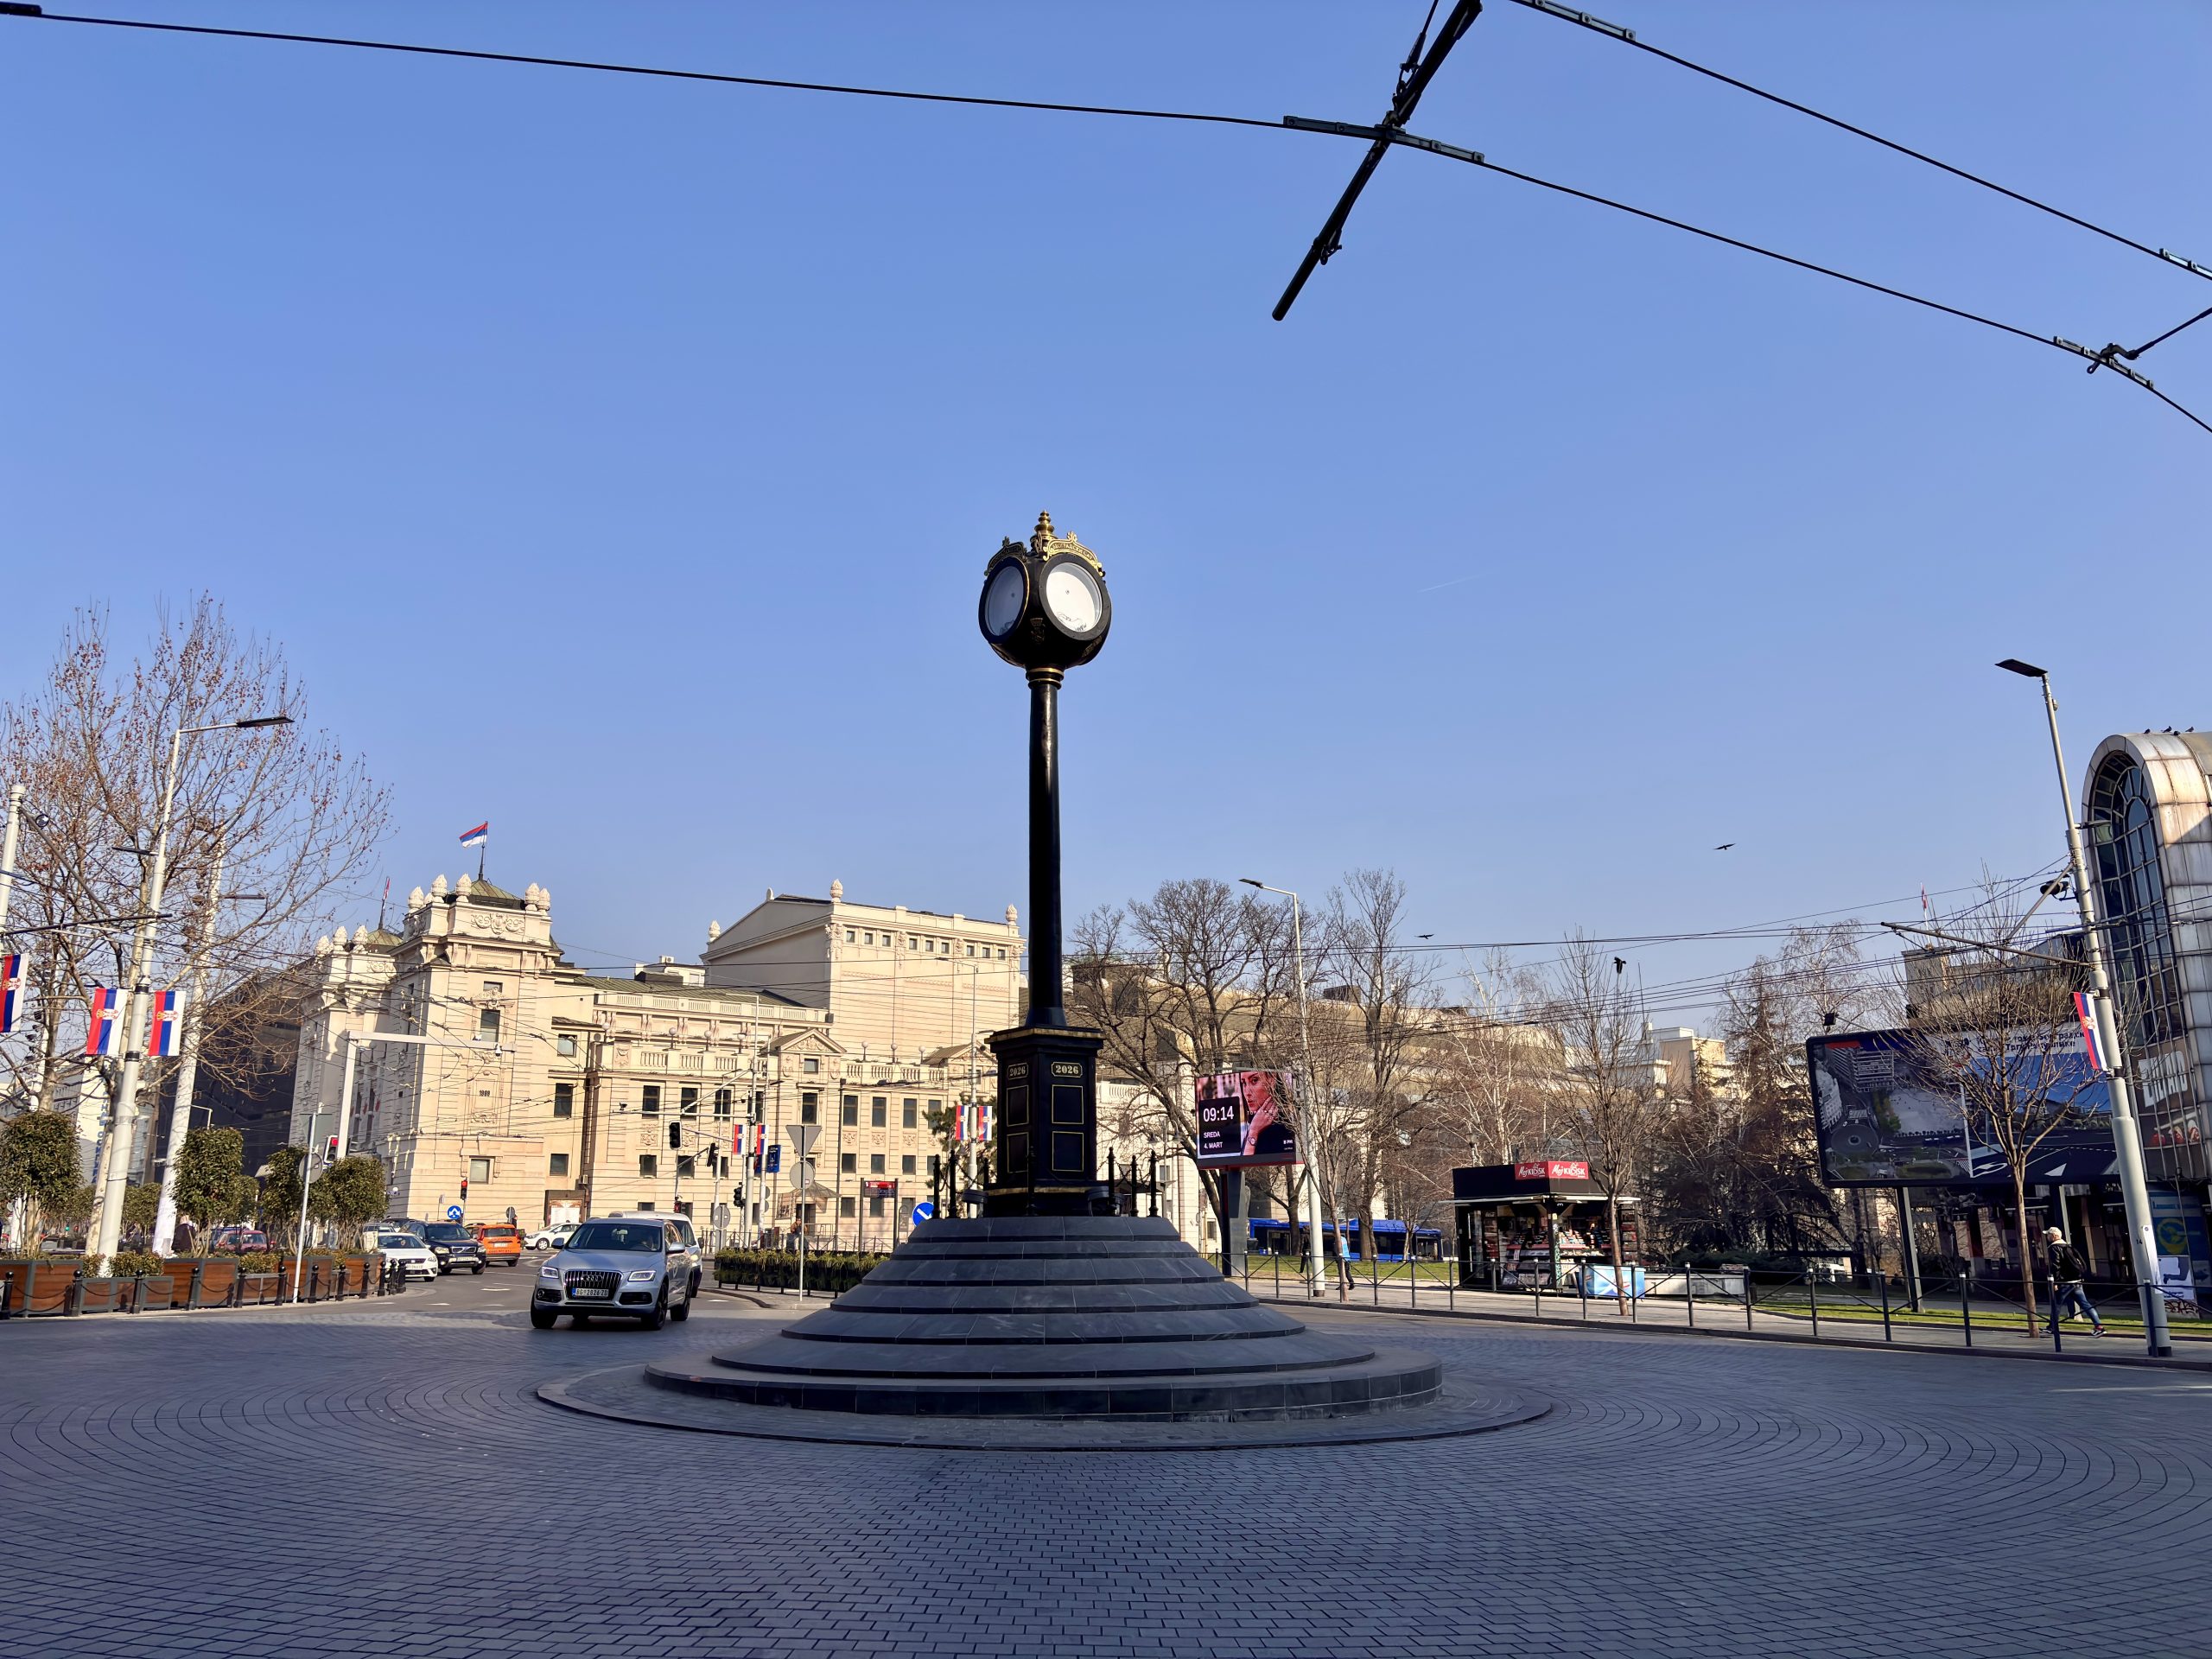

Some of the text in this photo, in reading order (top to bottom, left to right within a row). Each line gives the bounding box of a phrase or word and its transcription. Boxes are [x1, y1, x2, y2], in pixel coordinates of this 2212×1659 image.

[1009, 1065, 1026, 1077] 2026
[1055, 1065, 1079, 1075] 2026
[1203, 1106, 1234, 1122] 09:14
[1564, 1166, 1586, 1176] KIOSK
